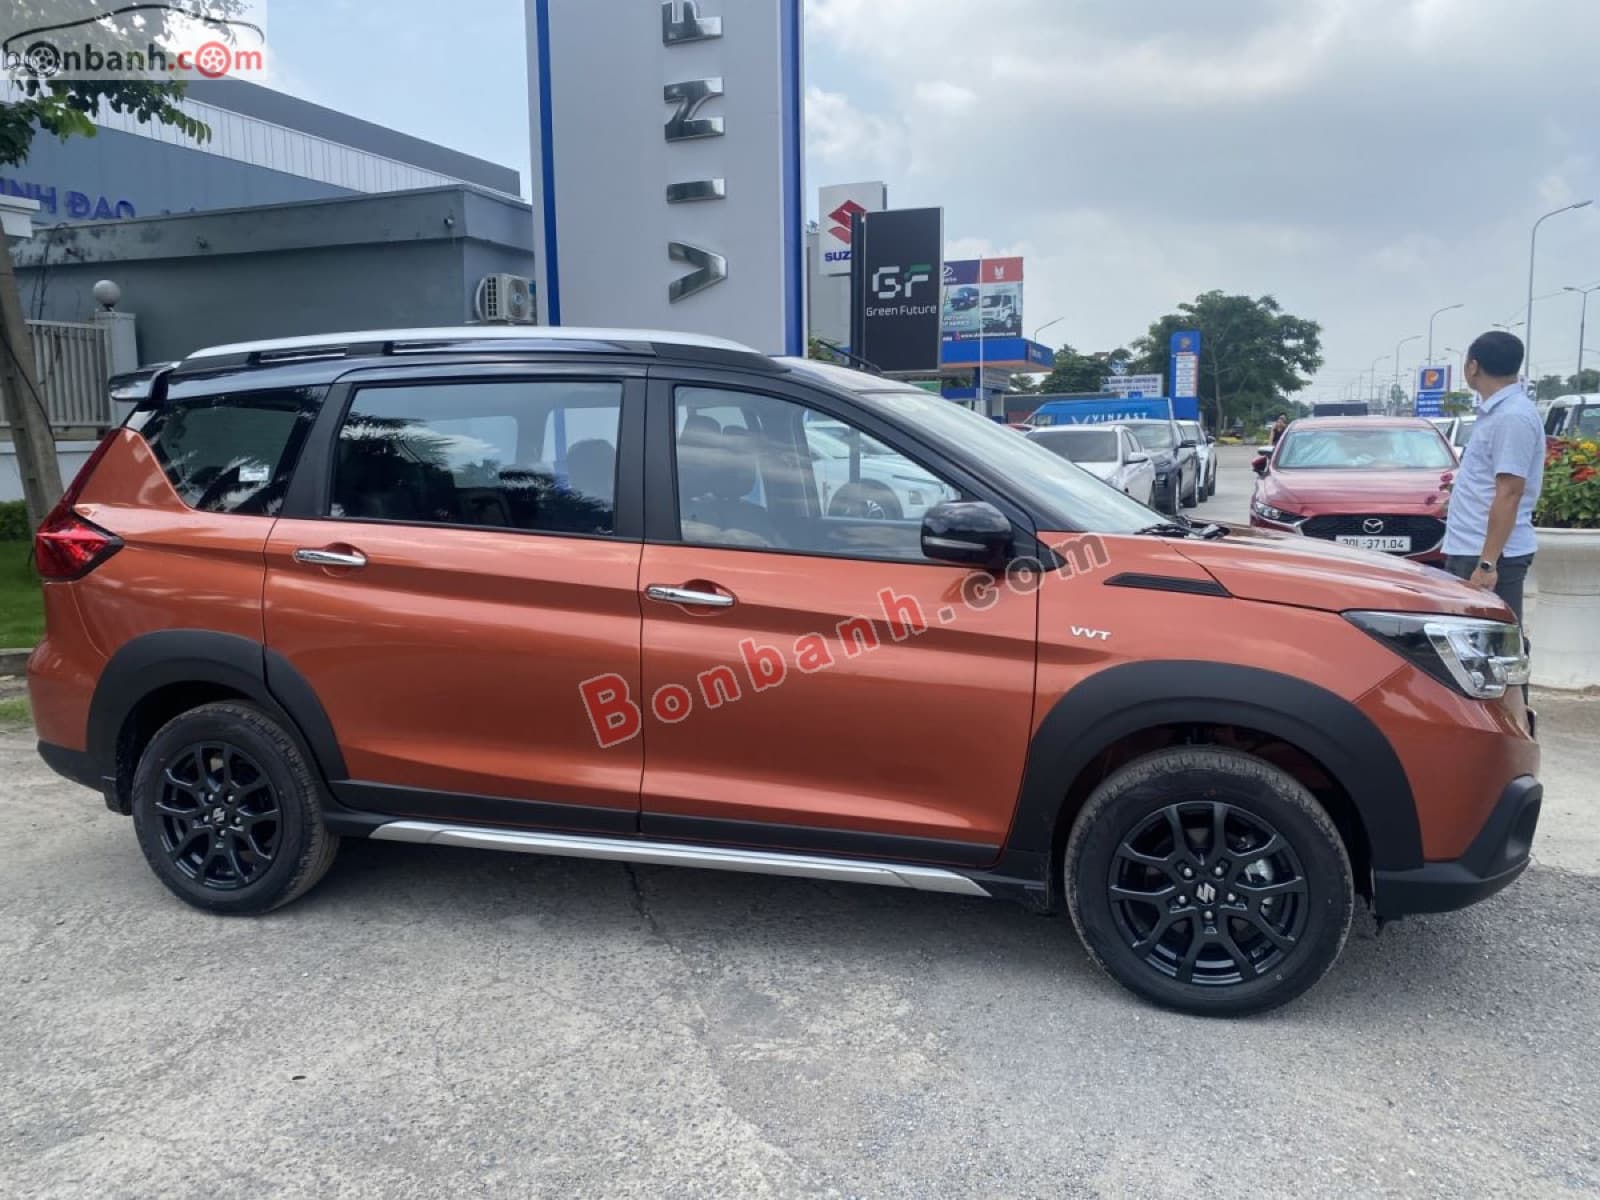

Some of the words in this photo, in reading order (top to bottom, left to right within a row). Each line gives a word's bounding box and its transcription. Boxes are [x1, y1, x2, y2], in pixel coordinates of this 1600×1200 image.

[872, 264, 932, 299] GF
[866, 306, 898, 317] Green
[900, 304, 937, 316] Future
[1070, 625, 1112, 641] VVT
